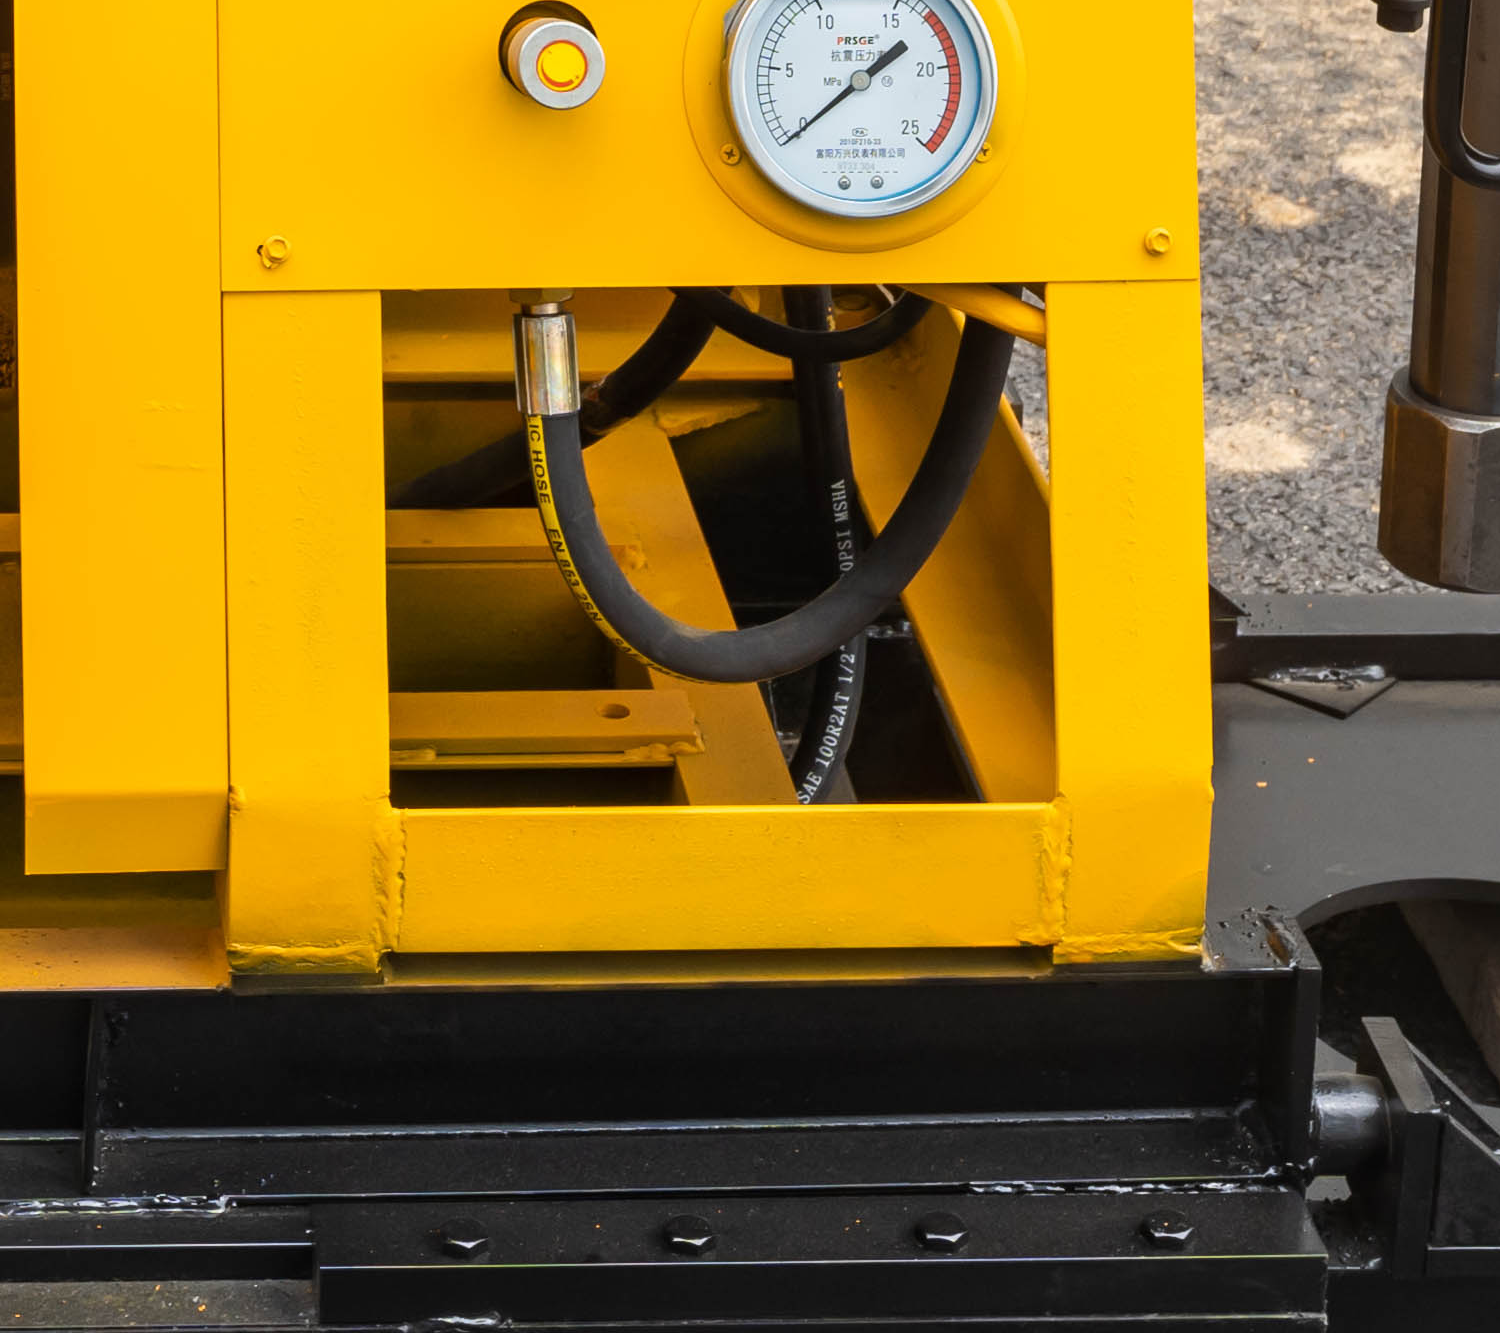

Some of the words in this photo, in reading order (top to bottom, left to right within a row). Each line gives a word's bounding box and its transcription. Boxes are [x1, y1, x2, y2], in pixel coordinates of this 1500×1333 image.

[816, 15, 834, 29] 10
[883, 14, 900, 28] 15
[837, 36, 874, 45] PRSGE
[786, 63, 794, 78] 5
[916, 62, 935, 77] 20
[823, 77, 842, 86] MPa
[901, 120, 919, 135] 25
[532, 449, 551, 504] HOSE
[549, 528, 565, 552] EN
[831, 478, 849, 523] MSHA
[815, 691, 850, 768] 100R2AT
[797, 771, 823, 805] SAE
